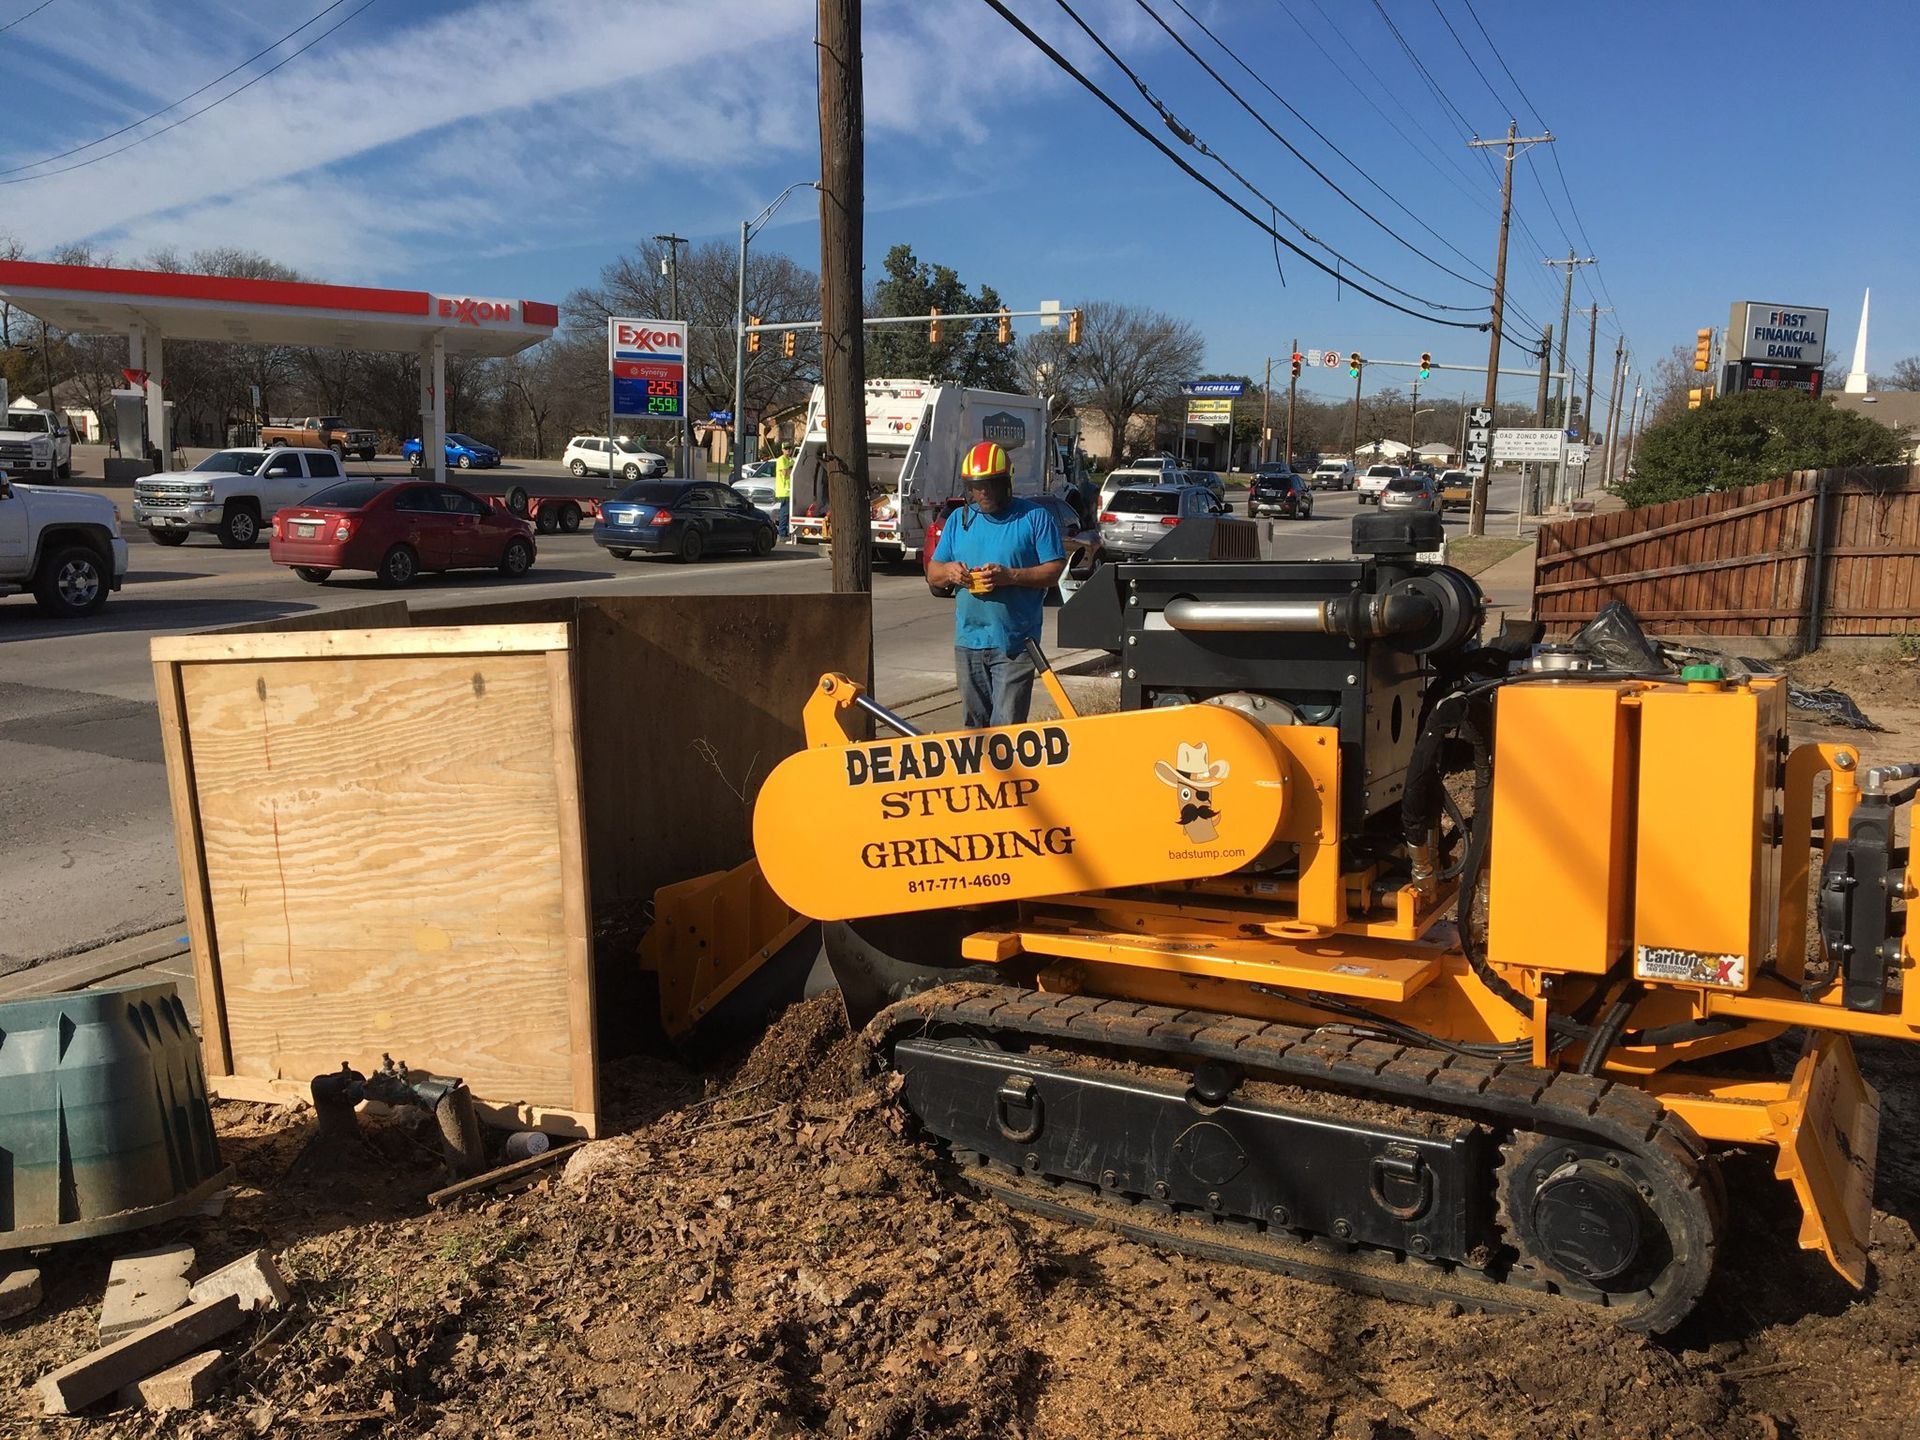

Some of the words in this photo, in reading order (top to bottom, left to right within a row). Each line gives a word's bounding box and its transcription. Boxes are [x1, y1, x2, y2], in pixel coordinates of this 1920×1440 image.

[438, 298, 511, 327] EXXON
[1769, 310, 1807, 327] FIRST
[617, 325, 682, 353] Exxon
[1754, 326, 1817, 344] FINANCIAL
[1766, 344, 1803, 360] BANK
[640, 369, 669, 378] Synergy
[984, 424, 1024, 440] WEATHERFORD
[845, 726, 1071, 787] DEADWOOD
[880, 778, 1040, 820] STUMP
[861, 826, 1076, 869] GRINDING
[1168, 848, 1246, 860] badstump.com
[908, 872, 1011, 893] 817-771-4609
[1645, 949, 1699, 968] Carlton
